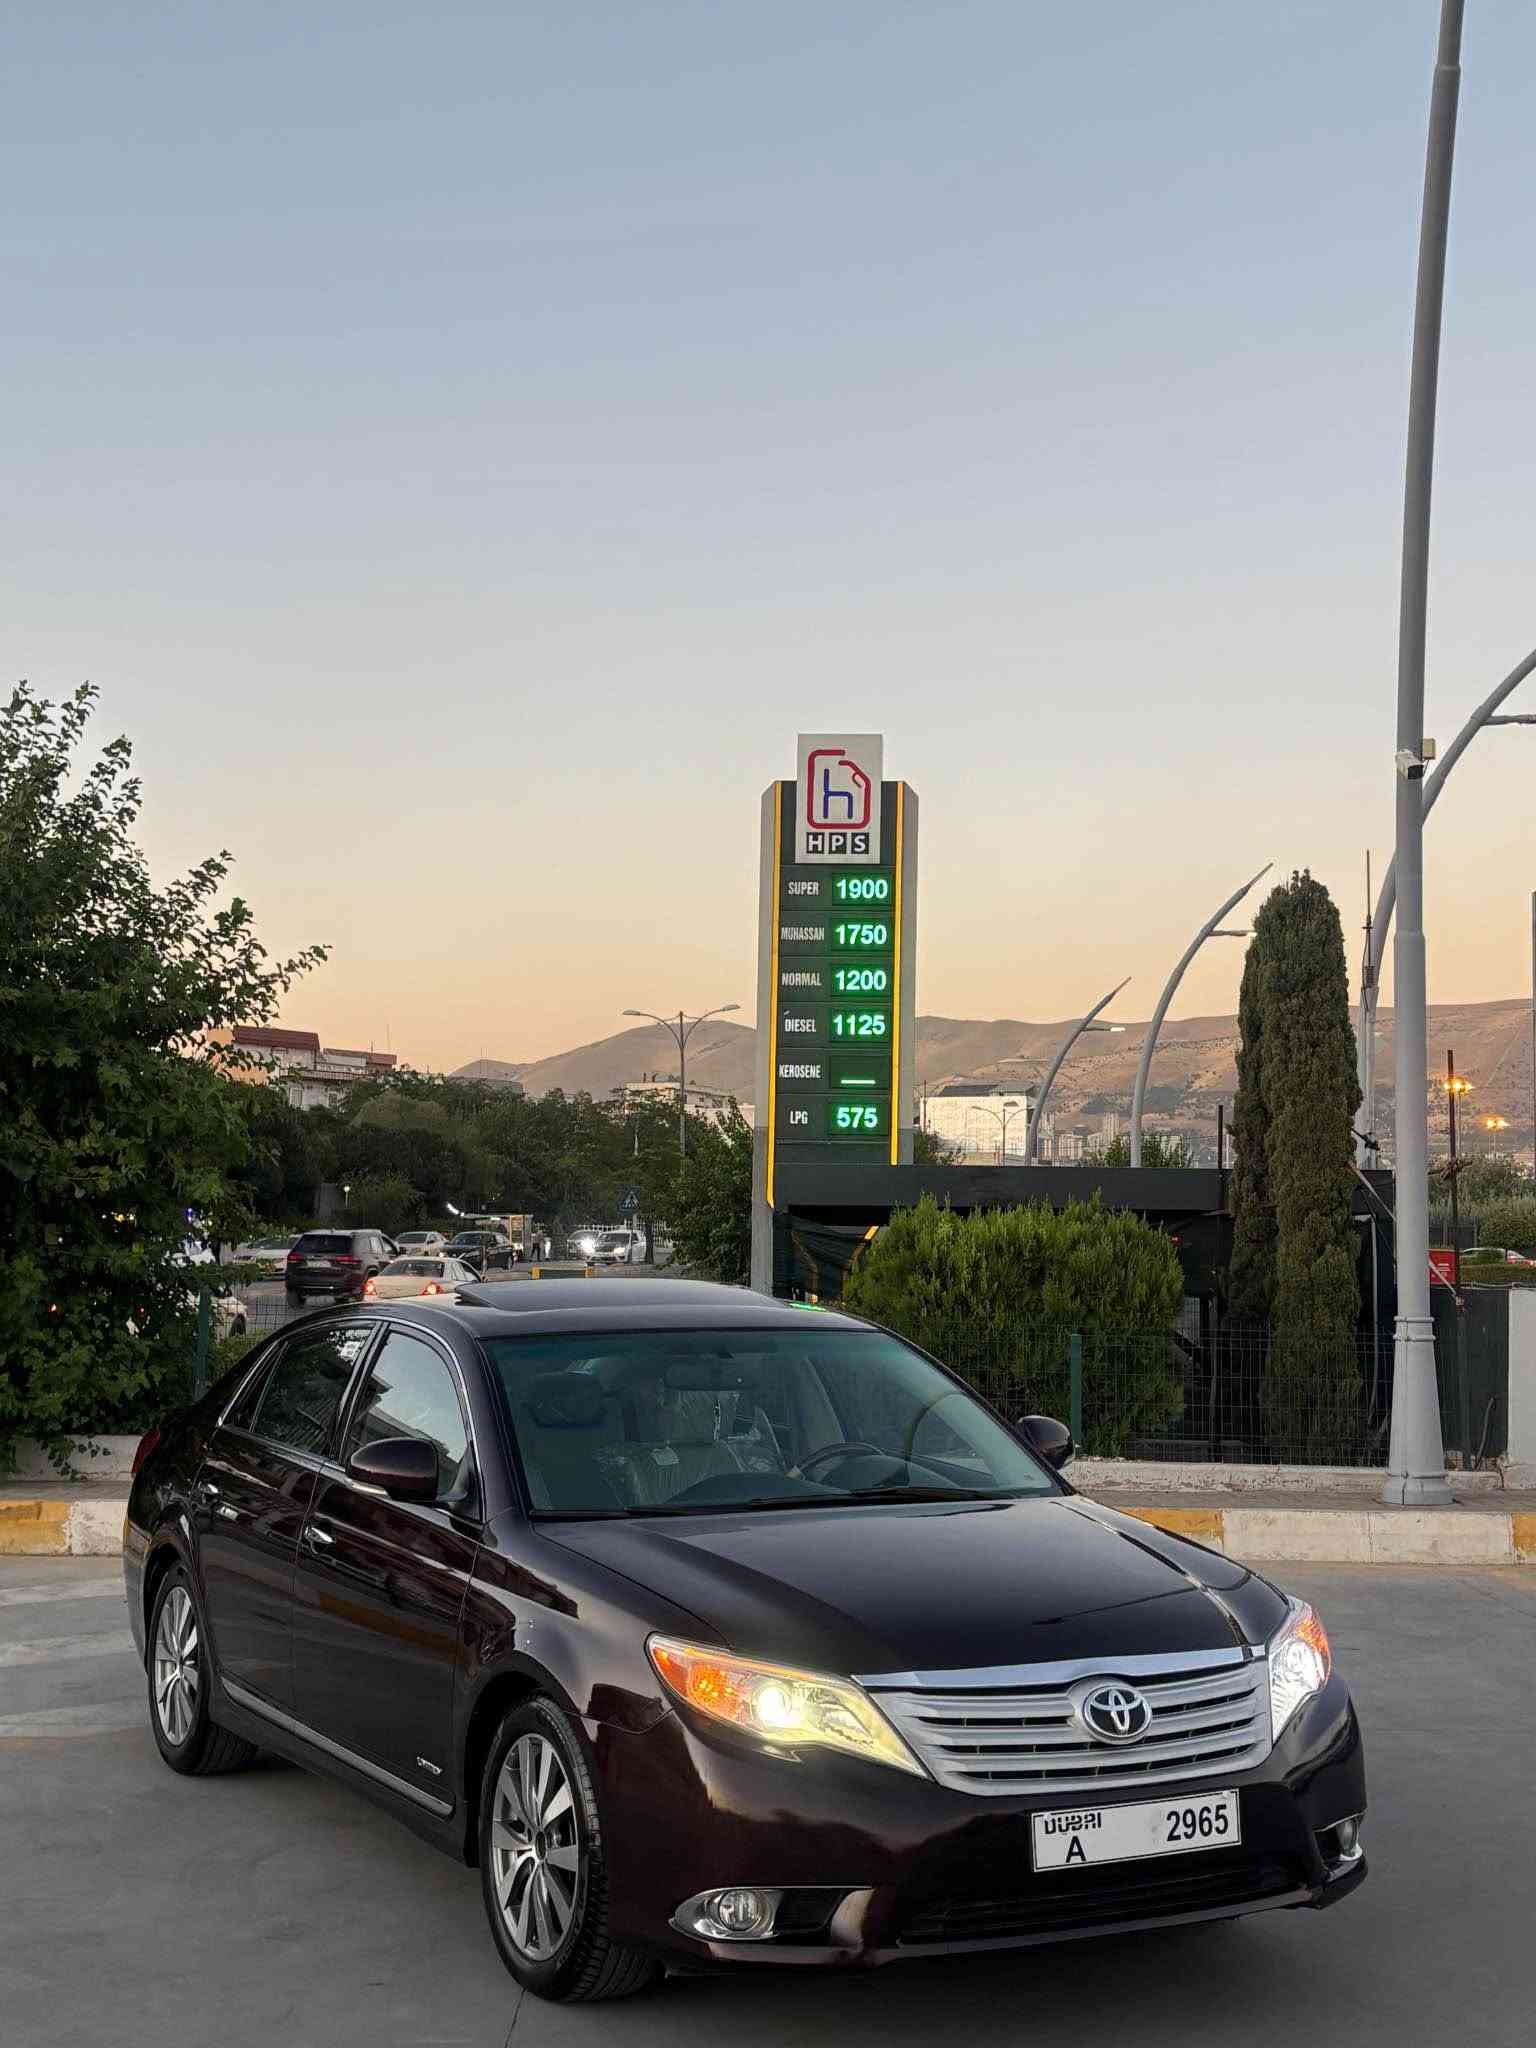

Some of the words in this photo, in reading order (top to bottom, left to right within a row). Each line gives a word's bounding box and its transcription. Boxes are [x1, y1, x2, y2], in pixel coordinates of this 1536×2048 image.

[807, 833, 868, 852] HPS
[788, 881, 819, 895] SUPER
[836, 879, 888, 899] 1900
[835, 924, 887, 945] 1750
[781, 972, 822, 986] NORMAL
[835, 969, 887, 990] 1200
[784, 1018, 817, 1032] DIESEL
[833, 1014, 886, 1035] 1125
[779, 1064, 821, 1078] KEROSENE
[789, 1110, 809, 1124] LPG
[836, 1106, 878, 1128] 575
[1166, 1804, 1229, 1842] 2965
[1065, 1835, 1087, 1863] A
